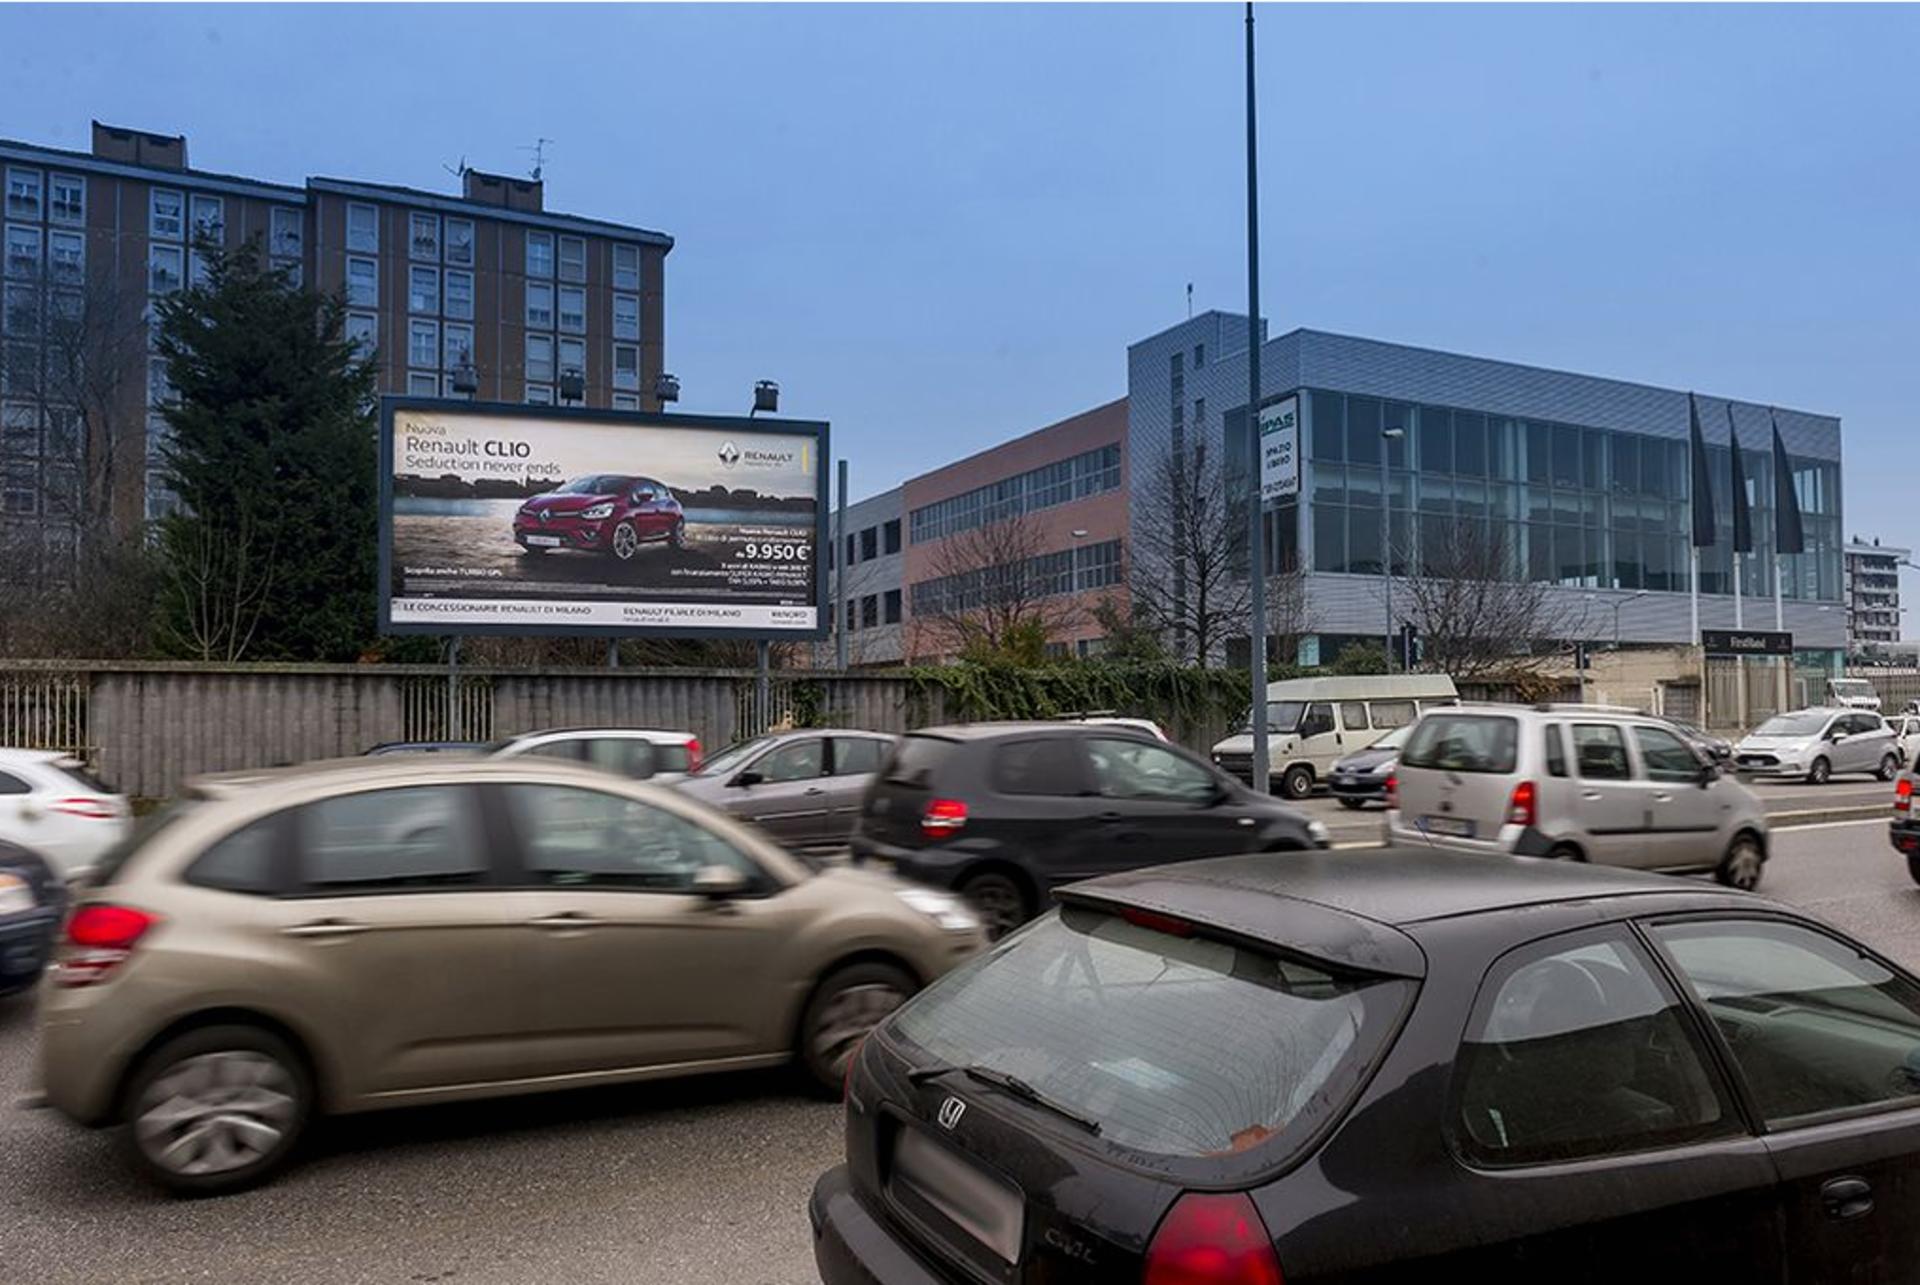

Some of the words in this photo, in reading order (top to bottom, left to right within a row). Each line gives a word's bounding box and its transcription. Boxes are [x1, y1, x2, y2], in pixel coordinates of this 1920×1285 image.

[405, 423, 446, 435] Nuova
[407, 437, 479, 455] Renault
[484, 440, 531, 458] CLIO
[744, 451, 793, 462] RENAULT
[406, 455, 480, 470] Seduction
[483, 460, 522, 472] never
[526, 461, 561, 474] ends
[745, 543, 795, 560] 9.950
[404, 603, 415, 612] LE
[417, 604, 498, 613] CONCESSIONARIE
[501, 605, 541, 613] RENAULT
[556, 606, 591, 615] MILANO
[623, 607, 664, 616] RENAULT
[707, 609, 741, 618] MILANO
